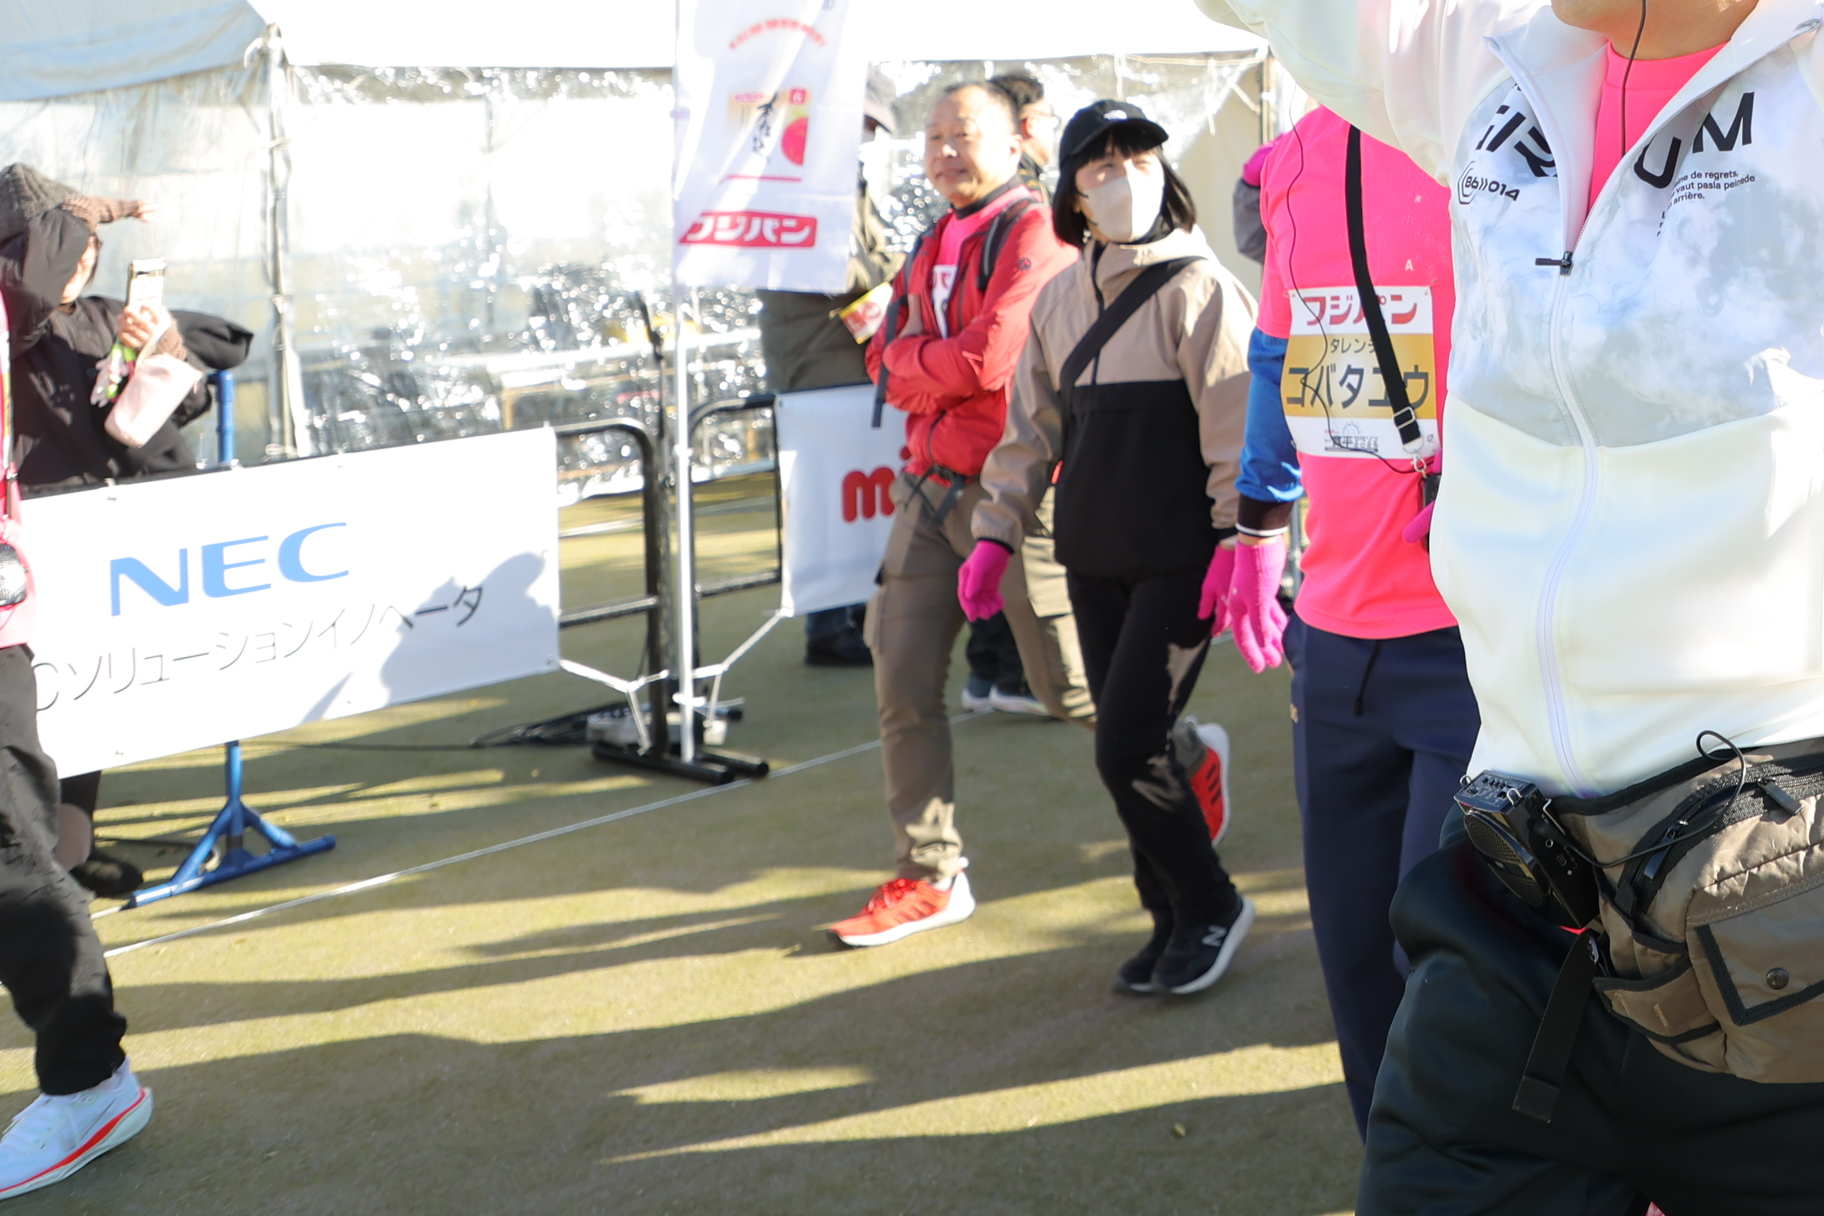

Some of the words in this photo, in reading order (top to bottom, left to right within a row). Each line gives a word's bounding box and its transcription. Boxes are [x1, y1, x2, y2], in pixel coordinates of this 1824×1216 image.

[1690, 170, 1703, 180] de
[1704, 170, 1739, 181] regrets,
[686, 214, 811, 244] フジパン
[109, 522, 350, 617] NEC
